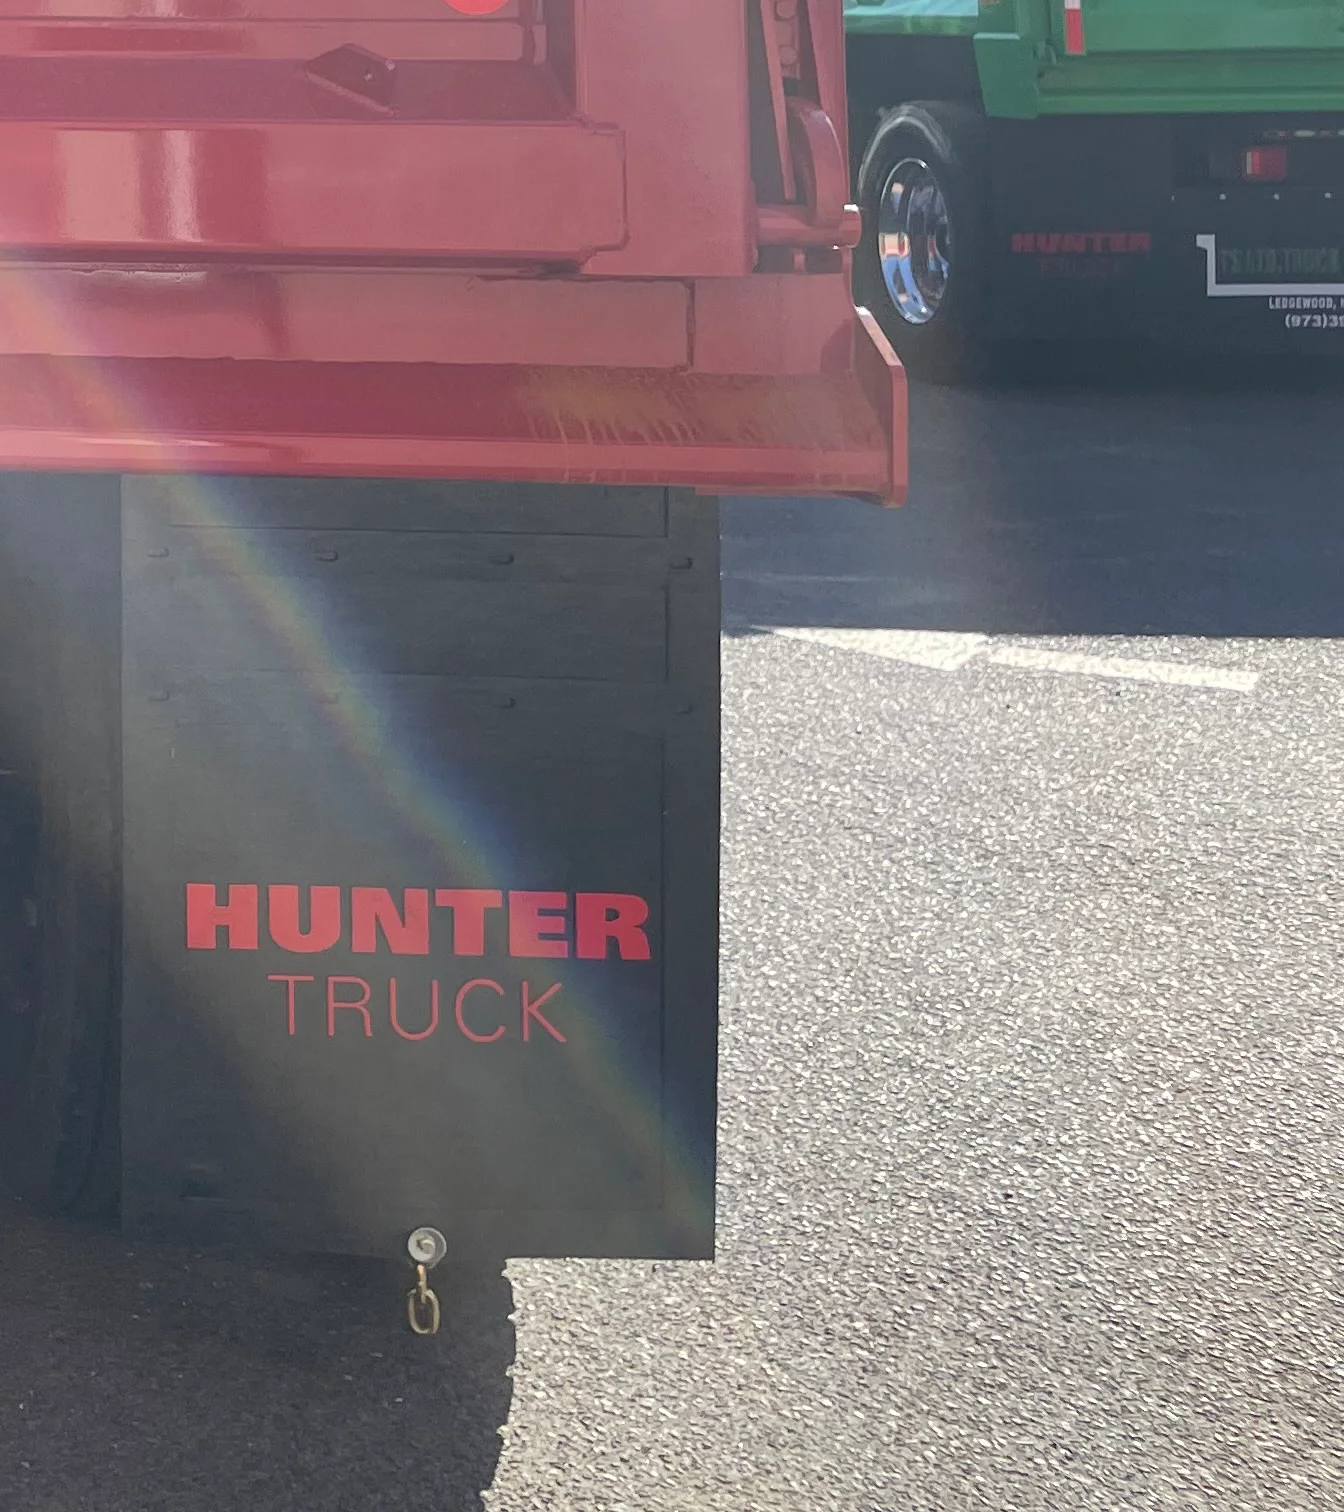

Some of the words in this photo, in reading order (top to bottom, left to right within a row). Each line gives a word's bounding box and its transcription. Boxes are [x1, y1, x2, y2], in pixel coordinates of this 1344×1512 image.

[1010, 232, 1152, 253] HUNTER
[186, 883, 652, 960] HUNTER
[267, 974, 568, 1044] TRUCK
